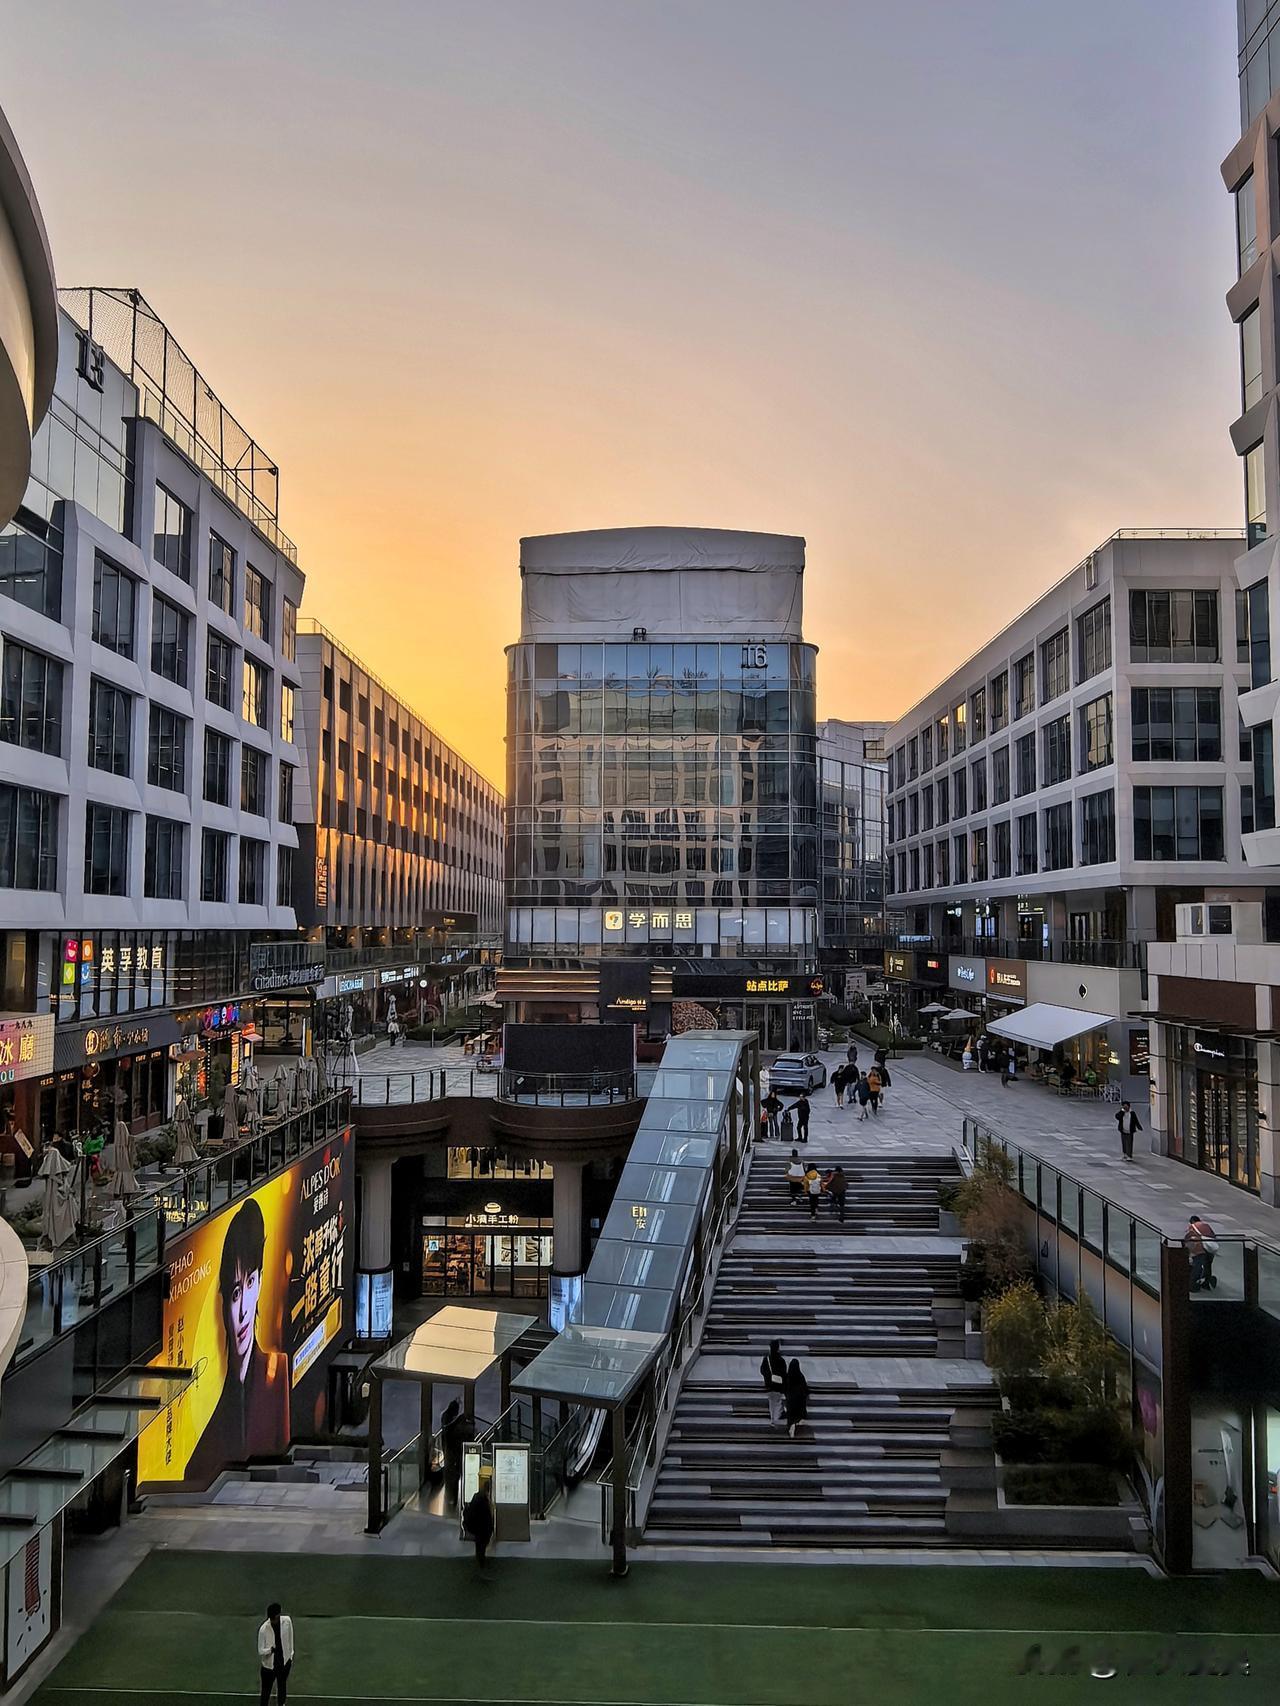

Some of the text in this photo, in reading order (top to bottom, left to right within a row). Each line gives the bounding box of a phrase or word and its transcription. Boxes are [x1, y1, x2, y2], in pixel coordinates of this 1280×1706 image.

[629, 913, 692, 928] 学而思
[101, 946, 163, 973] 英孚教育
[746, 980, 789, 992] 站点比萨
[300, 1169, 323, 1204] ALPES
[169, 1250, 194, 1279] ZHAO
[291, 1234, 344, 1323] 一路童行
[168, 1260, 212, 1304] XIAOTONG
